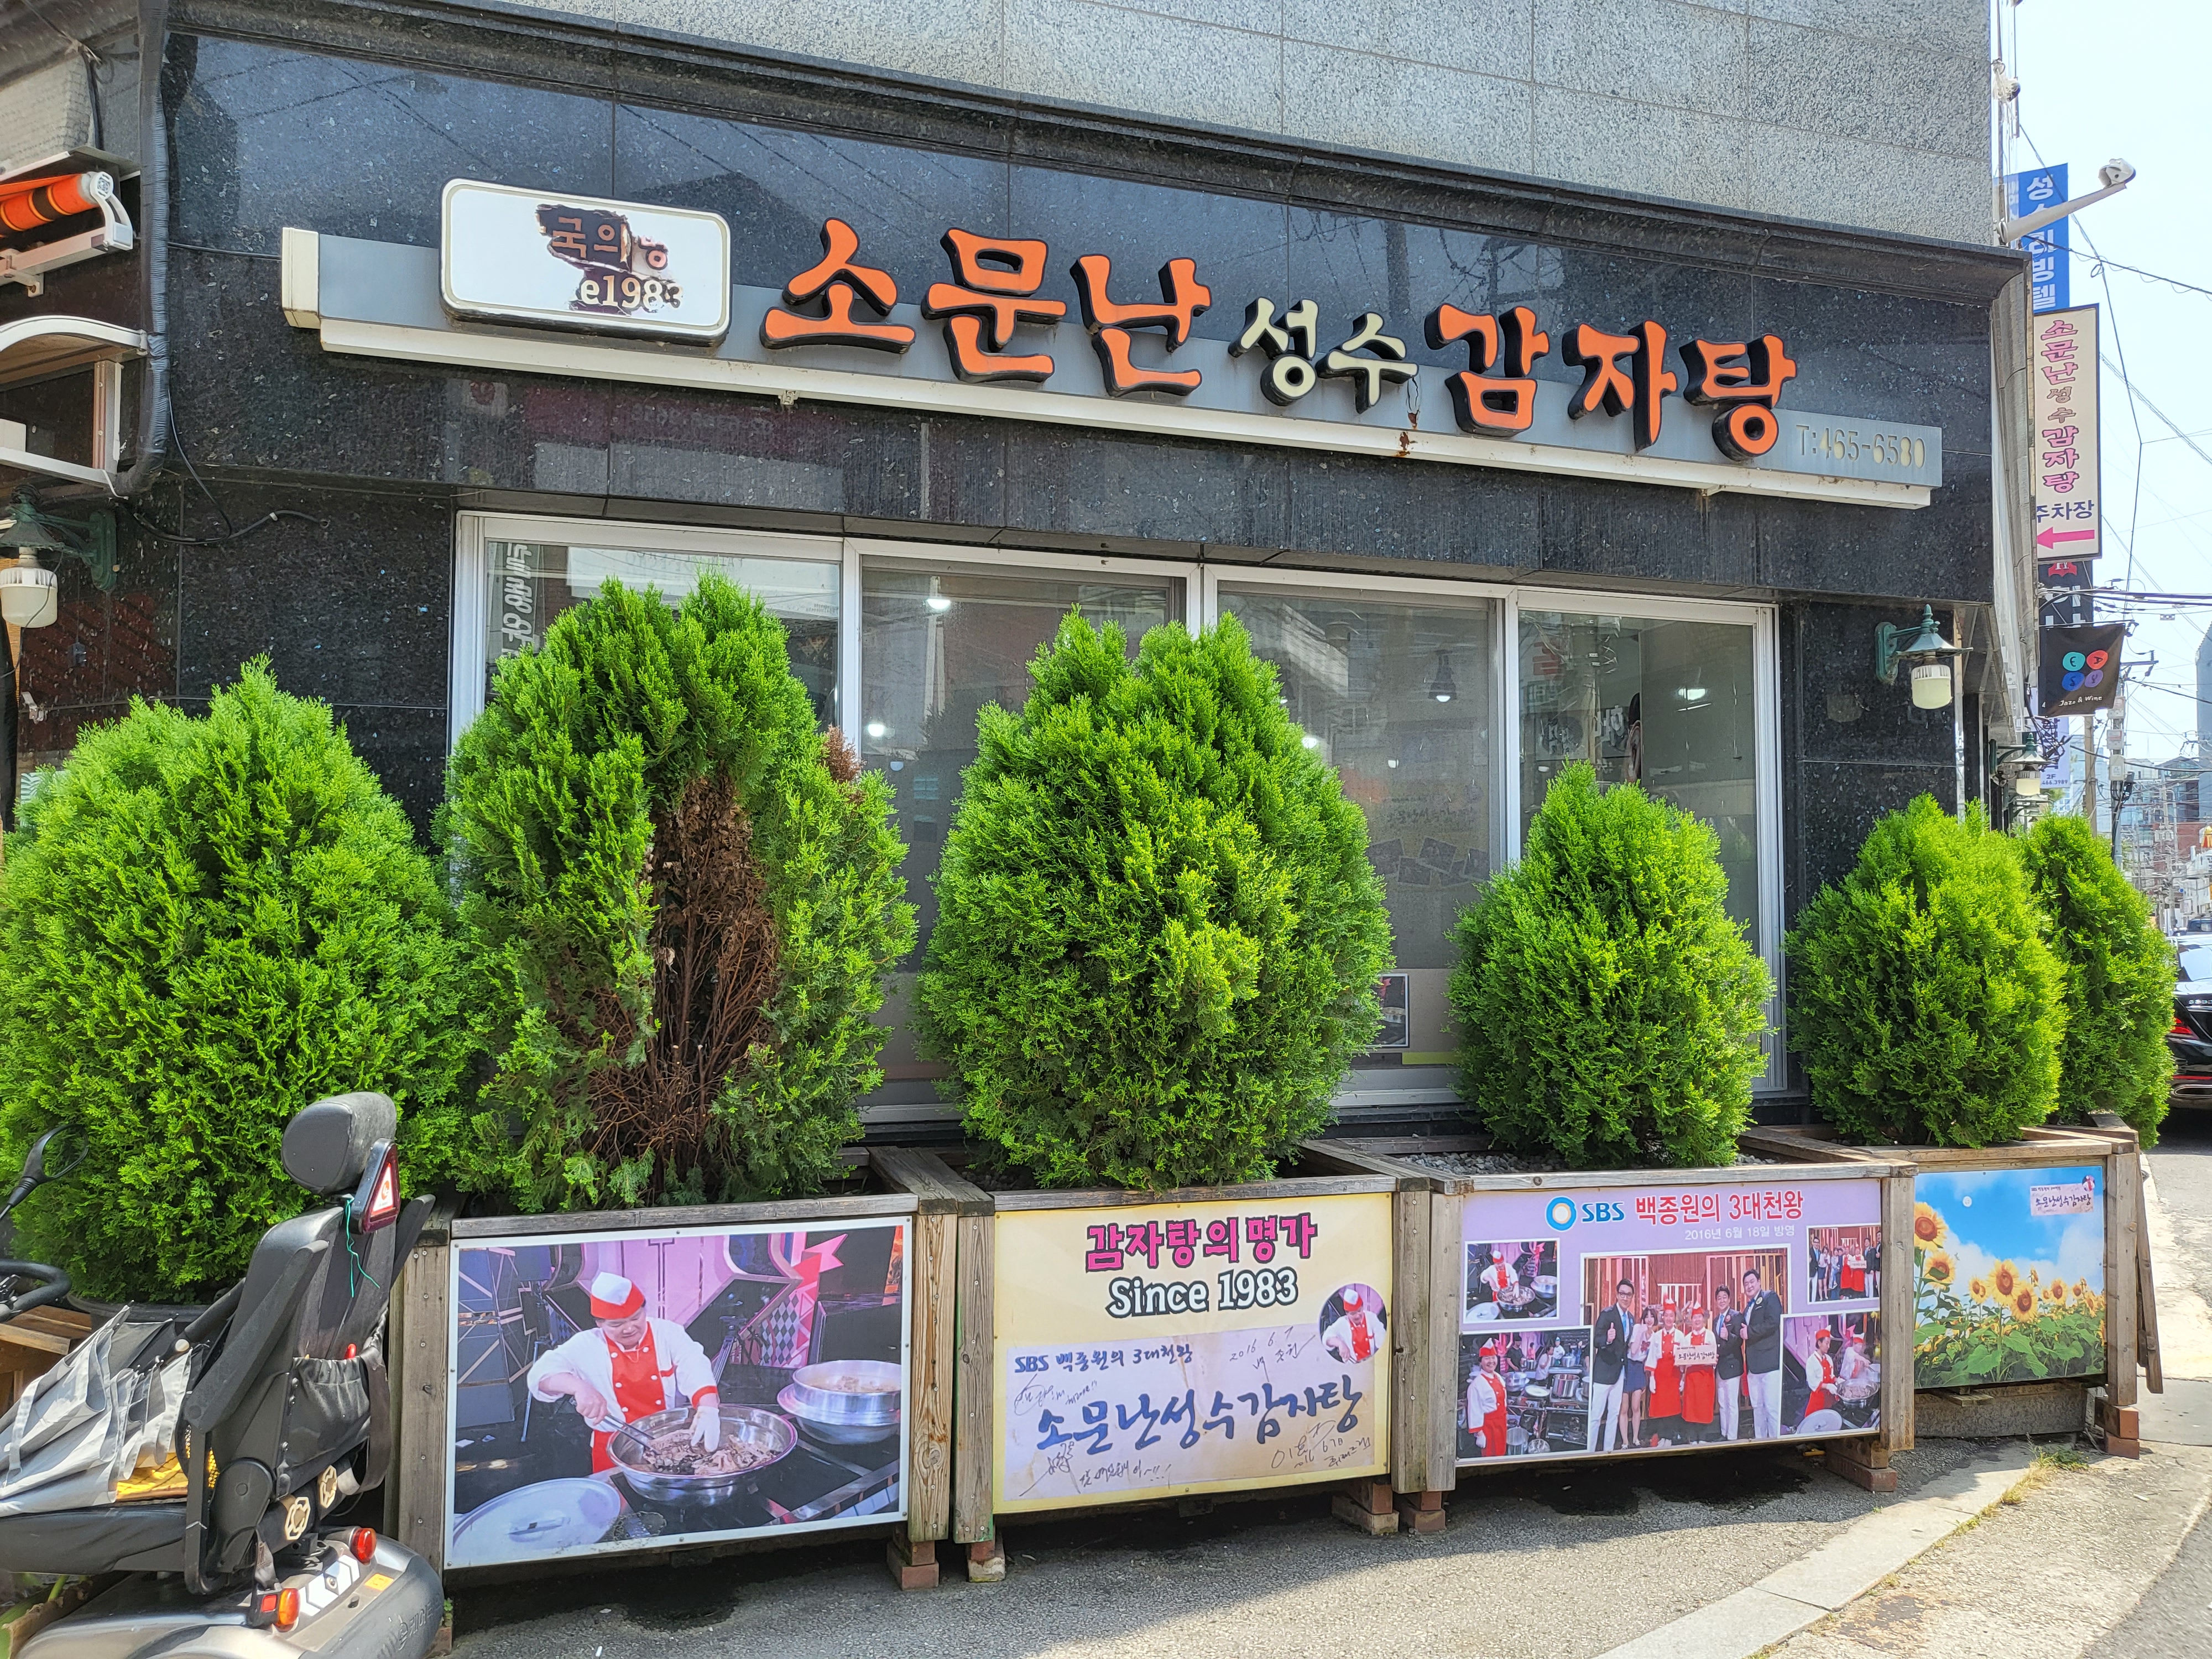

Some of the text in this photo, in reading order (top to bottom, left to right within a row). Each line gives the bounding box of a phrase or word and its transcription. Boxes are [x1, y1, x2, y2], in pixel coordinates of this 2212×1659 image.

[760, 217, 1797, 461] 소문난 성수 감자탕
[2036, 499, 2095, 522] 주차장
[1582, 1190, 1804, 1225] SBS 백종원의 3대천왕
[1684, 1224, 1795, 1240] 2016년 6월 18일 방영
[1105, 1266, 1298, 1318] Since 1983
[1014, 1355, 1050, 1373] SBS
[1056, 1350, 1124, 1372] 백종원의
